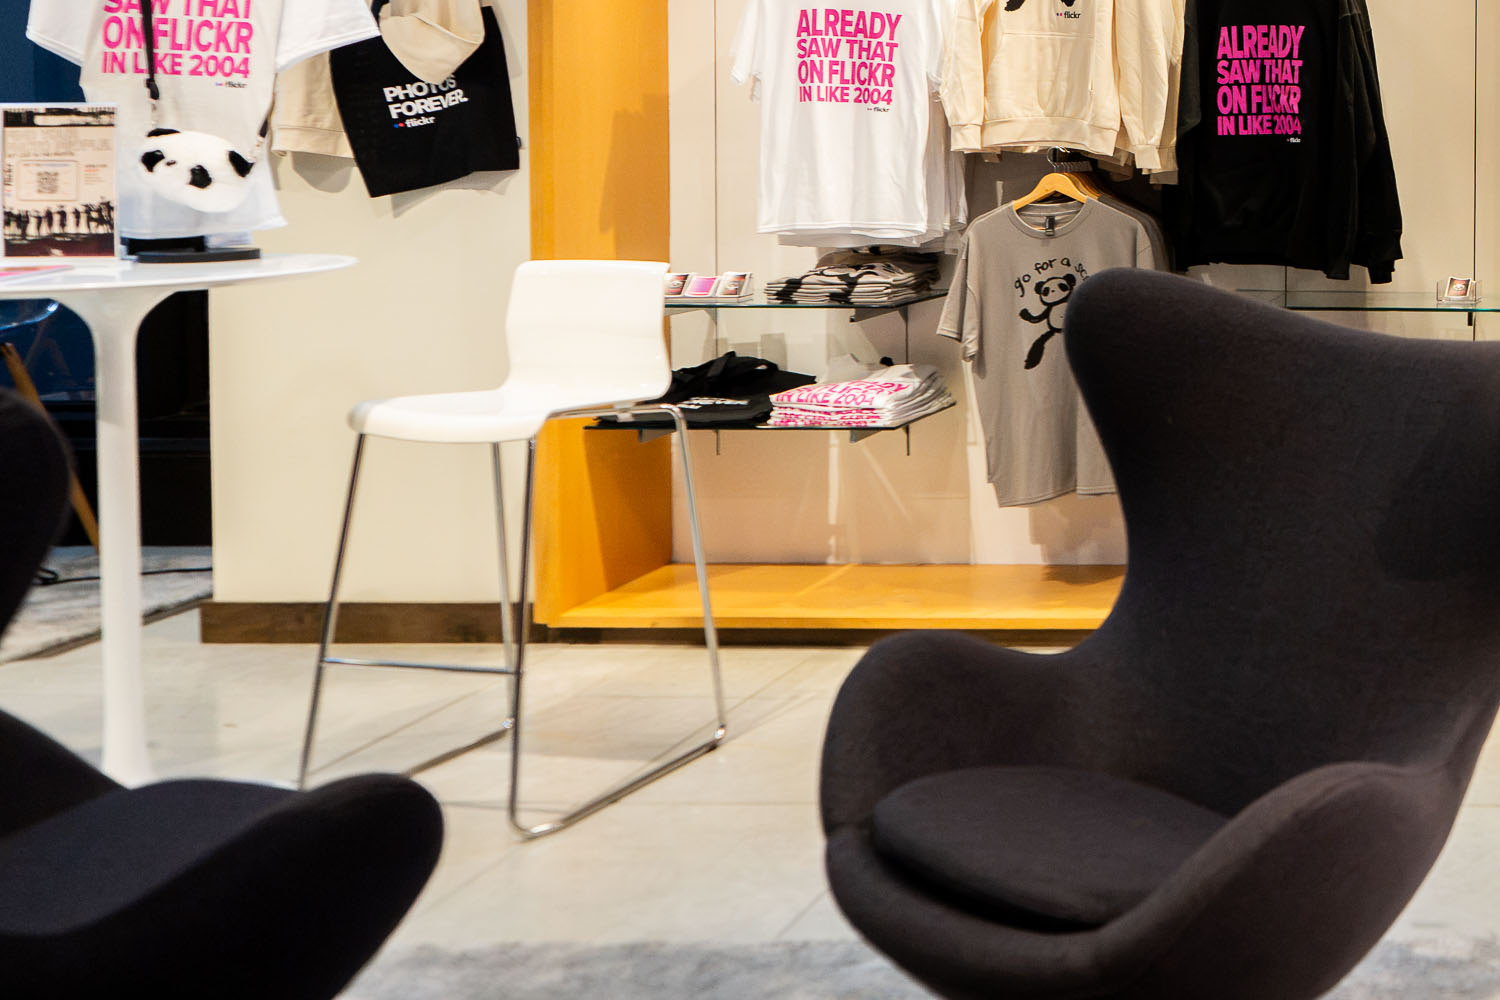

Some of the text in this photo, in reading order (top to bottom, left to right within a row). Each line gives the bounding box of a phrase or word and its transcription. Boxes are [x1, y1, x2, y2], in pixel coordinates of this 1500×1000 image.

[796, 8, 903, 41] ALREADY
[1063, 11, 1081, 19] flickr
[102, 16, 254, 54] ON FLICKR
[1216, 24, 1306, 60] ALREADY
[796, 37, 899, 63] SAW THAT
[102, 51, 250, 79] IN LKE 2004
[798, 59, 896, 88] ON FLICKR
[1217, 59, 1304, 85] SAW THAT
[387, 88, 470, 119] FOREVER.
[799, 85, 893, 105] IN LIKE 2004
[1216, 84, 1302, 115] ON FLICKR
[404, 116, 436, 128] flickr
[1217, 114, 1302, 136] IN LIKE 2004
[1014, 273, 1032, 298] go
[1033, 258, 1057, 275] for
[1060, 257, 1071, 268] a
